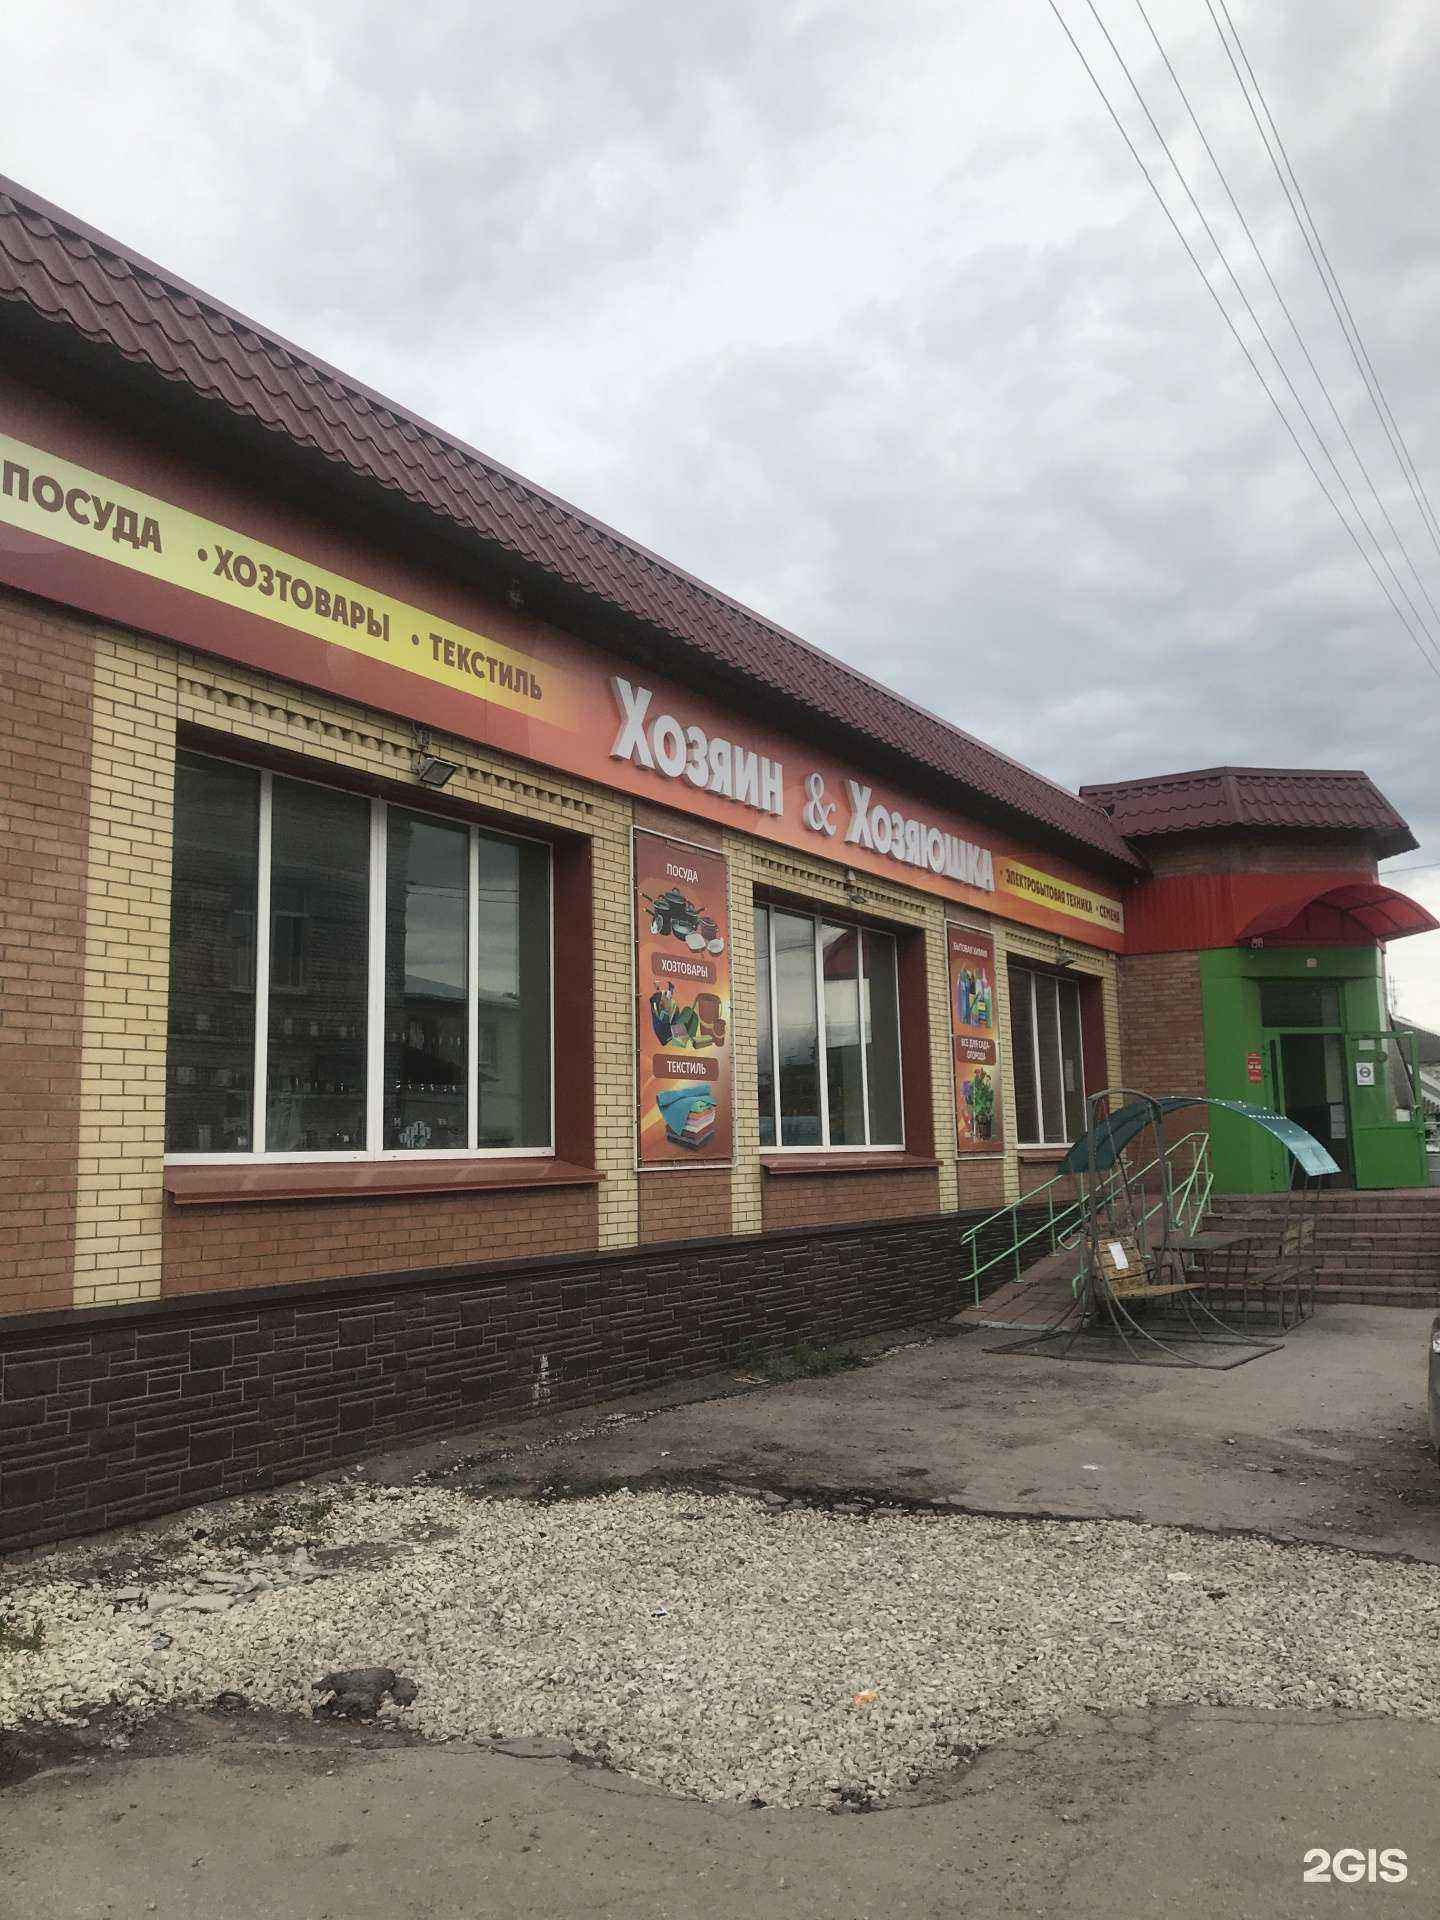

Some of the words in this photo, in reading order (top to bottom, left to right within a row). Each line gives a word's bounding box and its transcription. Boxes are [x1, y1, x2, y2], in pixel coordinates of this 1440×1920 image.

[3, 460, 162, 554] ПОСУДА
[213, 545, 390, 642] ХОЗТОВАРЫ
[429, 632, 543, 701] ТЕКСТИЛЬ
[803, 772, 837, 837] &
[666, 863, 699, 883] ПОСУДА
[1005, 868, 1066, 904] ЭЛЕКТРОБЫТОВАЯ
[1066, 891, 1094, 914] ТЕХНИКА
[661, 958, 708, 978] ХОЗТОВАРЫ
[667, 1060, 707, 1076] ТЕКСТИЛЬ
